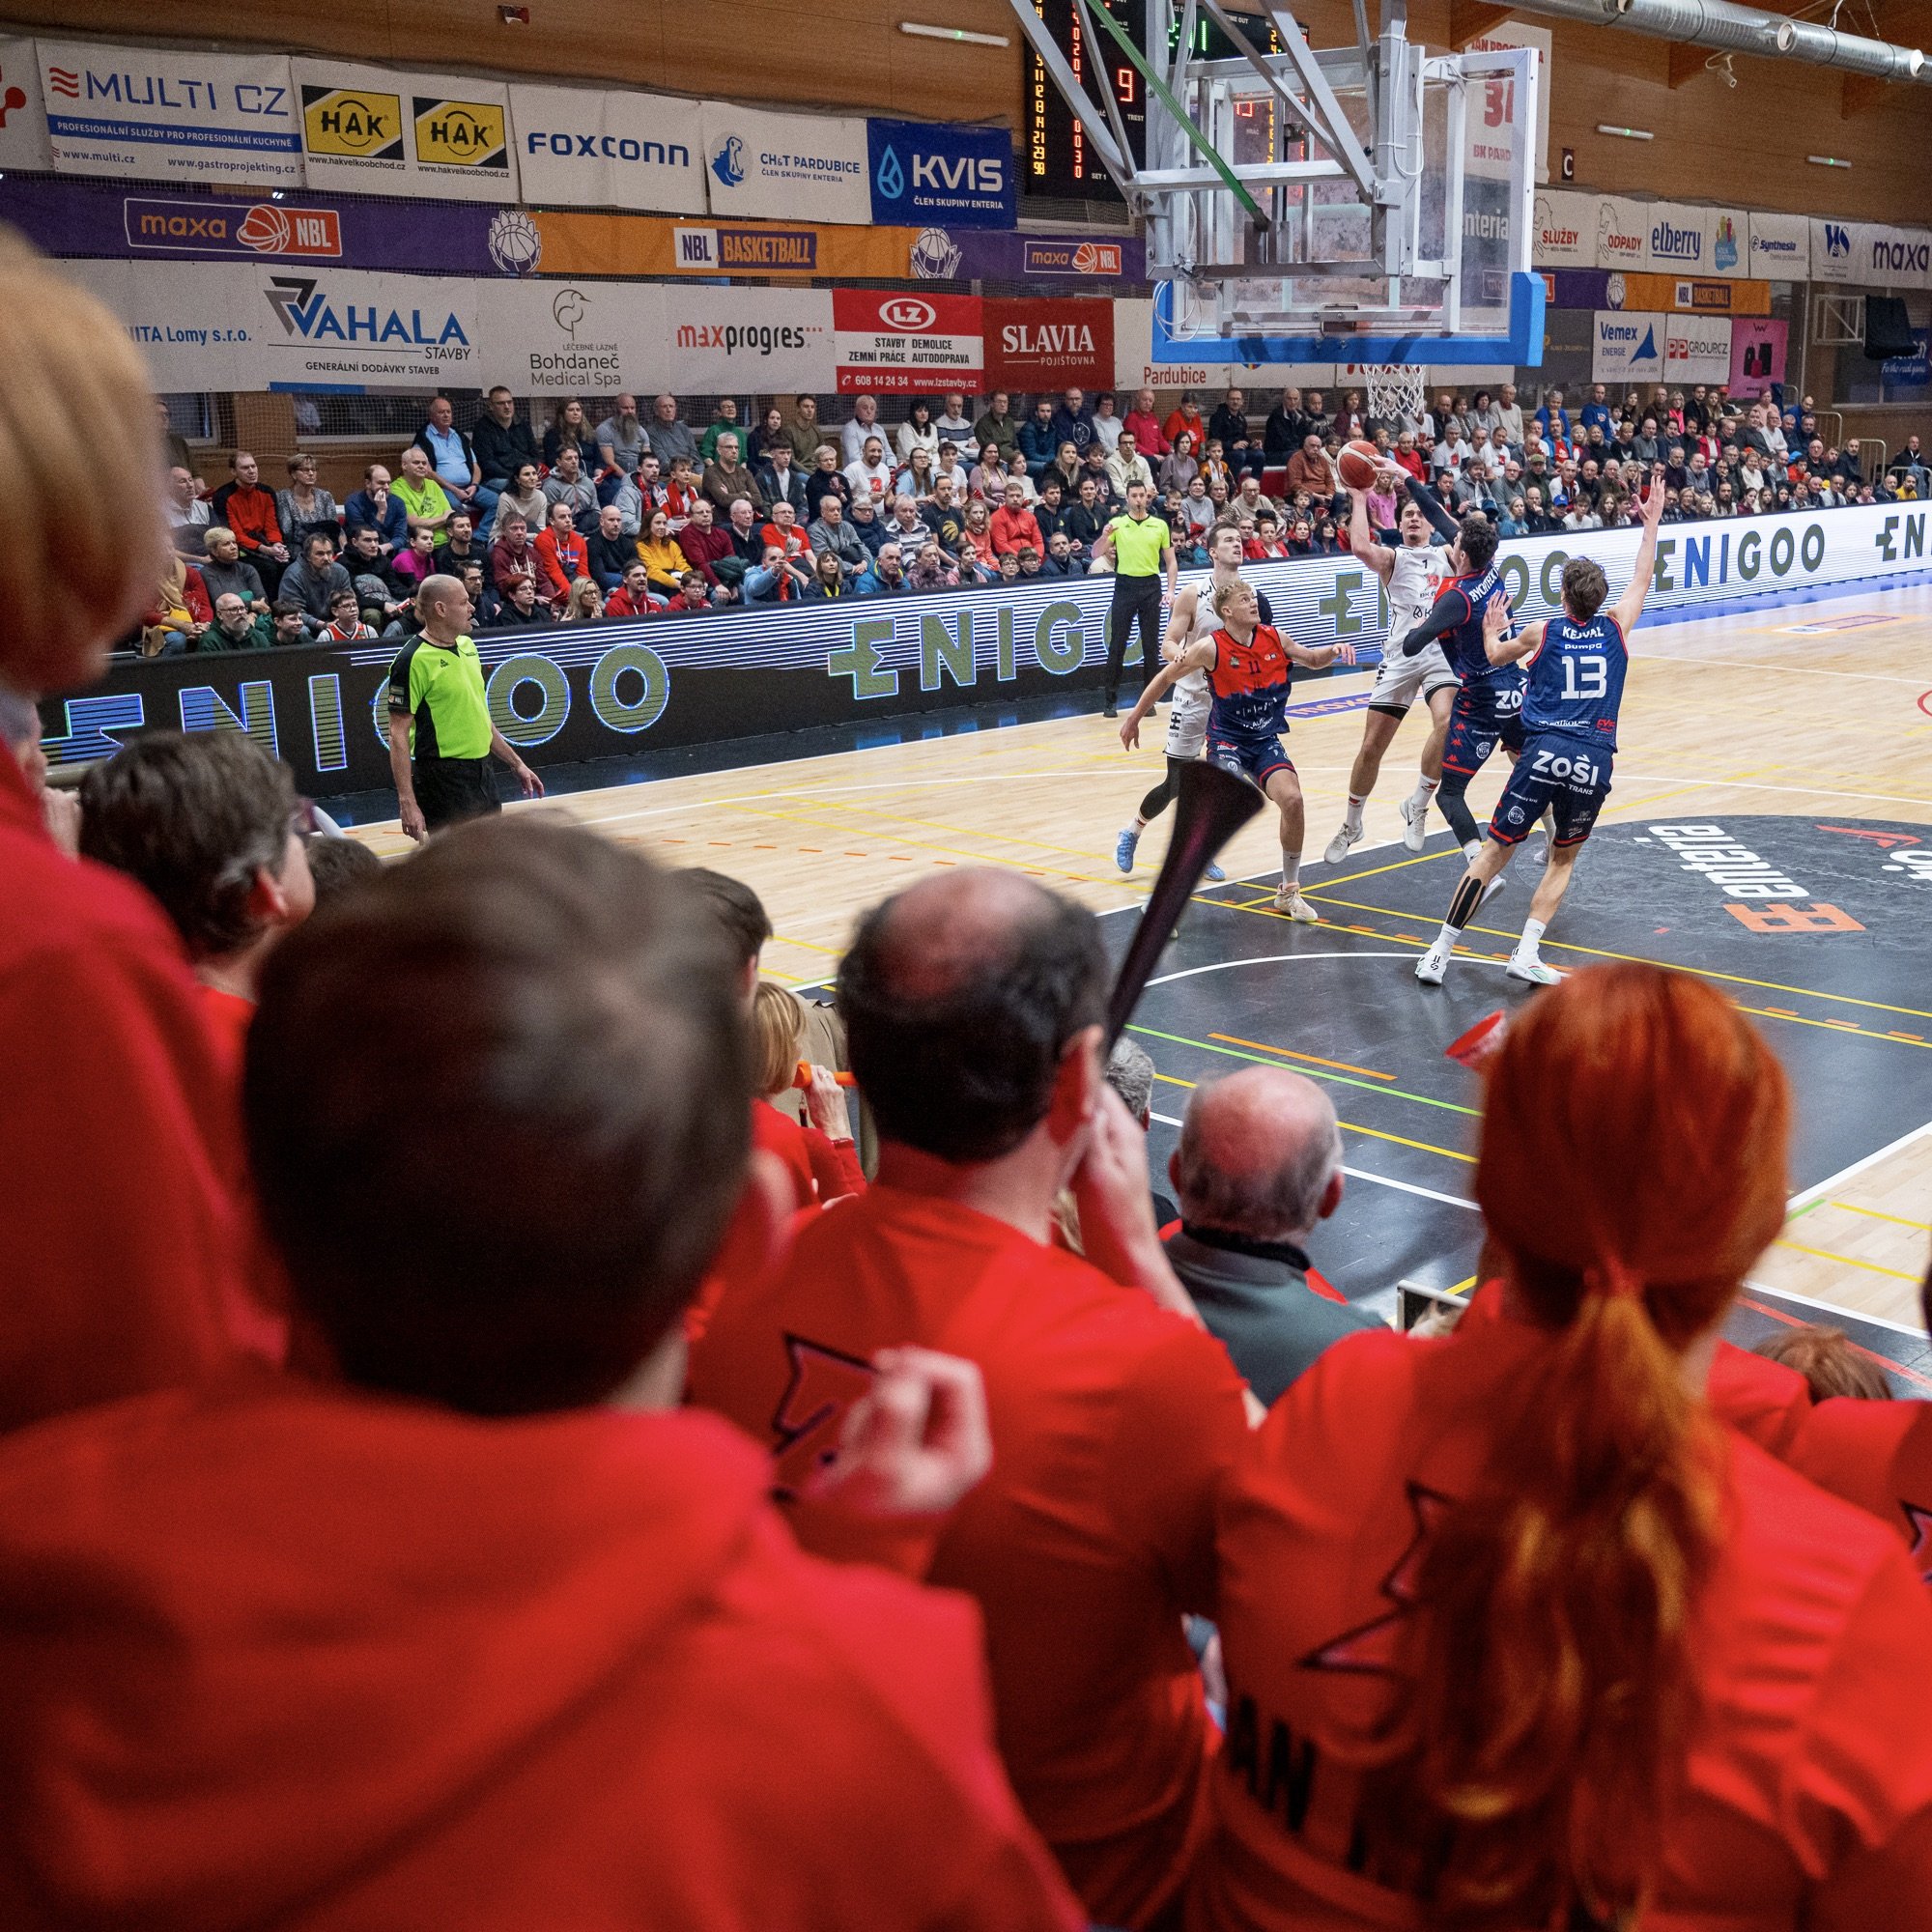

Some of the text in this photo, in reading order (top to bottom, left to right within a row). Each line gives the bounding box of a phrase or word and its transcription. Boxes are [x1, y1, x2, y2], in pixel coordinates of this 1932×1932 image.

[86, 71, 289, 116] MULTI CZ
[1119, 69, 1133, 101] 9
[130, 128, 164, 138] SLUŽBY
[167, 130, 185, 139] PRO
[321, 111, 384, 138] HAK
[431, 122, 489, 147] HAK
[63, 151, 296, 174] www.multi.cz www.gastroprojekting.cz
[308, 156, 406, 170] www.hakvelkoobchod.cz
[418, 164, 510, 178] www.hakvelkoobchod.cz
[760, 154, 860, 173] CH&T PARDUBICE
[1563, 155, 1574, 177] C
[762, 168, 842, 183] ČLEN SKUPINY ENTERIA
[913, 154, 1003, 192] KVIS
[914, 195, 1004, 209] ČLEN SKUPINY ENTERIA
[140, 214, 331, 247] maxa NBL
[1462, 209, 1509, 241] nteria
[1543, 227, 1578, 244] SLUŽBY
[1607, 234, 1642, 251] ODPADY
[1652, 222, 1701, 261] elberry
[724, 236, 811, 263] BASKETBALL
[1759, 240, 1796, 252] Synthesia
[1873, 241, 1930, 270] maxa
[1031, 249, 1118, 270] maxa NBL
[286, 294, 469, 346] VAHALA
[892, 305, 923, 324] LZ
[166, 327, 207, 346] Lomy
[213, 329, 252, 342] s.r.o.
[677, 325, 805, 355] maxprogres
[1003, 325, 1095, 354] SLAVIA
[1600, 321, 1637, 341] Vemex
[425, 346, 471, 360] STAVBY
[562, 343, 595, 352] LÉČEBNÉ
[875, 337, 952, 350] STAVBY DEMOLICE
[530, 353, 620, 369] Bohdaneč
[848, 350, 970, 364] ZEMNÍ PRÁCE AUTODOPRAVA
[305, 360, 440, 375] GENERÁLNÍ DODÁVKY STAVEB
[1144, 366, 1207, 384] Pardubice
[531, 371, 621, 388] Medical Spa
[855, 375, 977, 388] 608 14 24 34 www.lzstavby.cz
[1876, 513, 1932, 561] EN
[1654, 524, 1825, 592] ENIGOO
[1248, 660, 1262, 674] 11
[1560, 655, 1608, 700] 13
[40, 642, 670, 772] ENIOO
[1532, 750, 1599, 786] ZOŠI
[1568, 783, 1594, 795] TRANS
